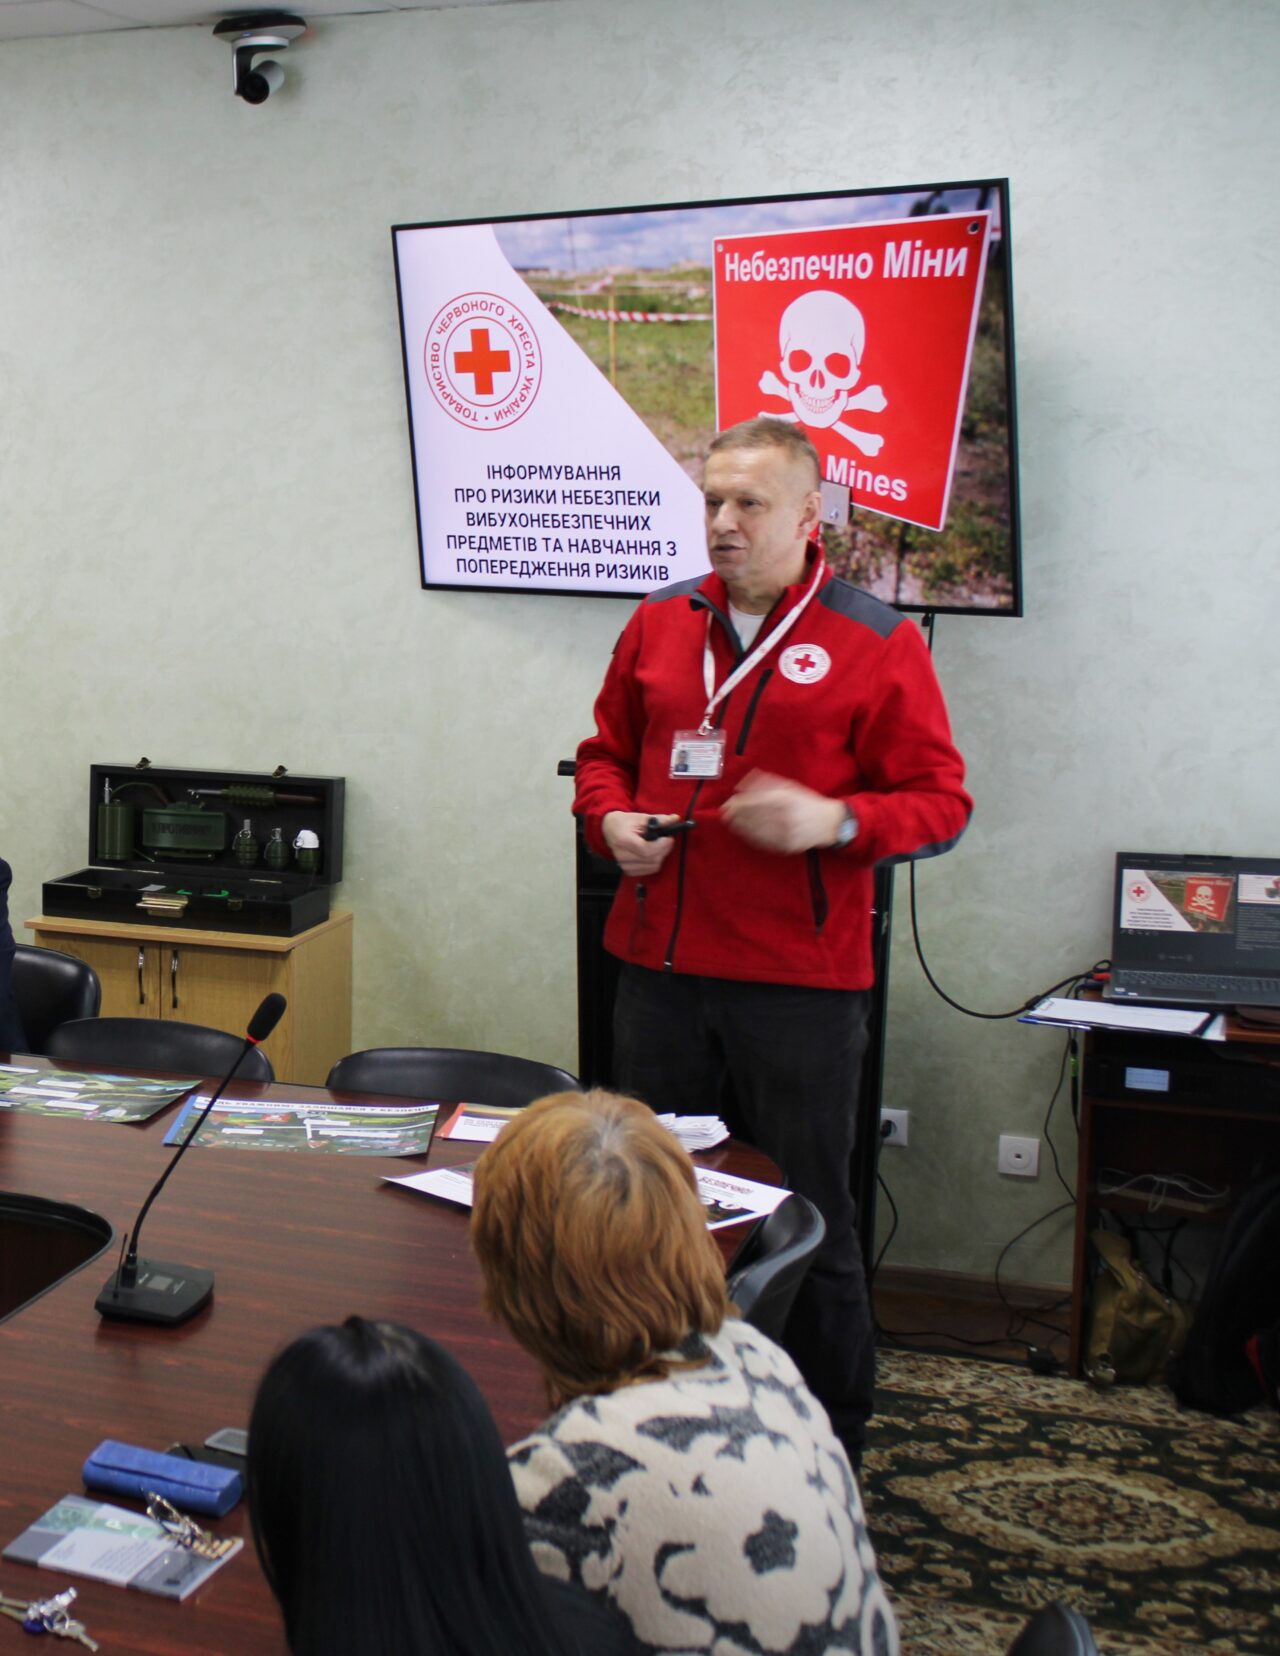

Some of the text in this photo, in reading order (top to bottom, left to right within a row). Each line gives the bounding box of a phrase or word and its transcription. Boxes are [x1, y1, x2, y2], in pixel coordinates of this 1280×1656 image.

[724, 240, 968, 282] Небезпечно Міни
[430, 300, 535, 422] ТОВАРИСТВО ЧЕРВОНОГО ХРЕСТА УКРАЇНИ
[486, 464, 621, 481] ІНФОРМУВАННЯ
[825, 454, 908, 501] Mines
[454, 488, 661, 506] ПРО РИЗИКИ НЕБЕЗПЕКИ
[466, 512, 652, 531] ВИБУХОНЕБЕЗПЕЧНИХ
[446, 535, 677, 557] ПРЕДМЕТІВ ТА НАВЧАННЯ З
[456, 558, 669, 581] ПОПЕРЕДЖЕННЯ РИЗИКІВ
